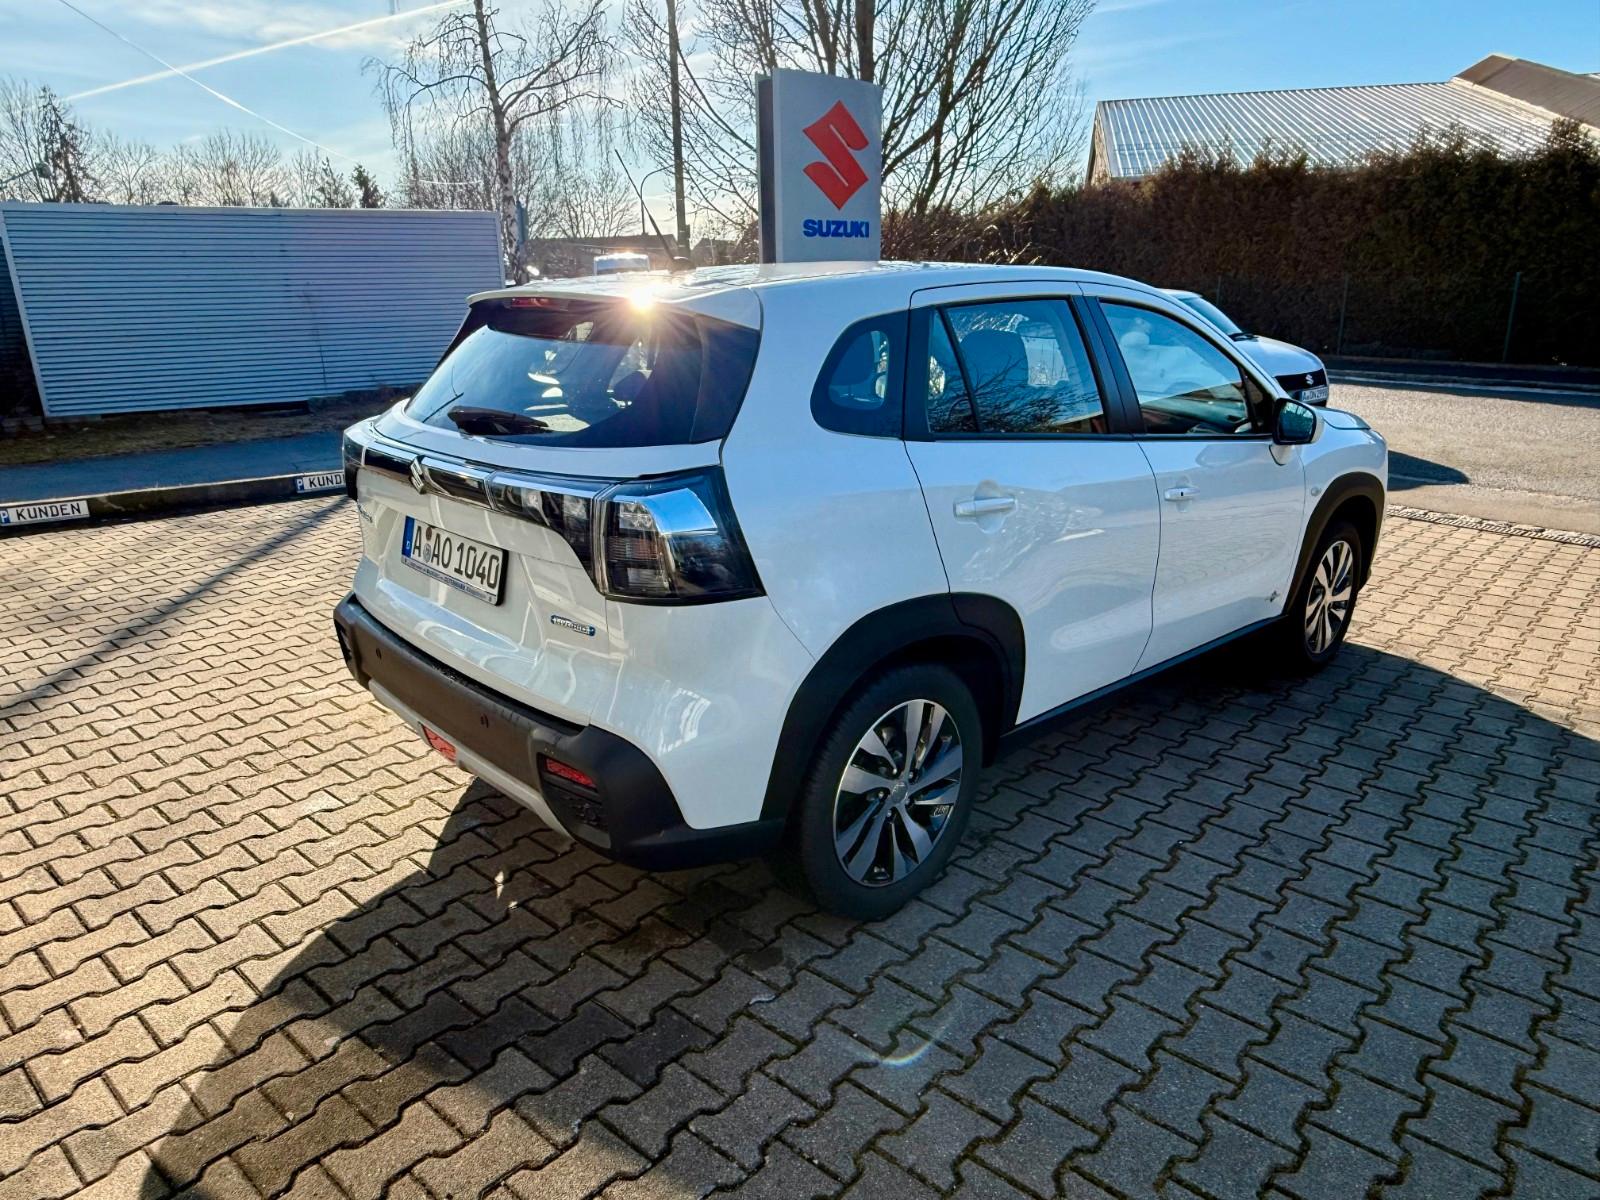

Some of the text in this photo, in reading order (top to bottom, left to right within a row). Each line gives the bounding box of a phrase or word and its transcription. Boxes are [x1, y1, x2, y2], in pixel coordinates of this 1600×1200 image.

[803, 219, 870, 239] SUZUKI
[308, 473, 345, 488] KUND
[15, 502, 82, 521] KUNDEN
[412, 525, 422, 558] A
[453, 541, 500, 590] 1040
